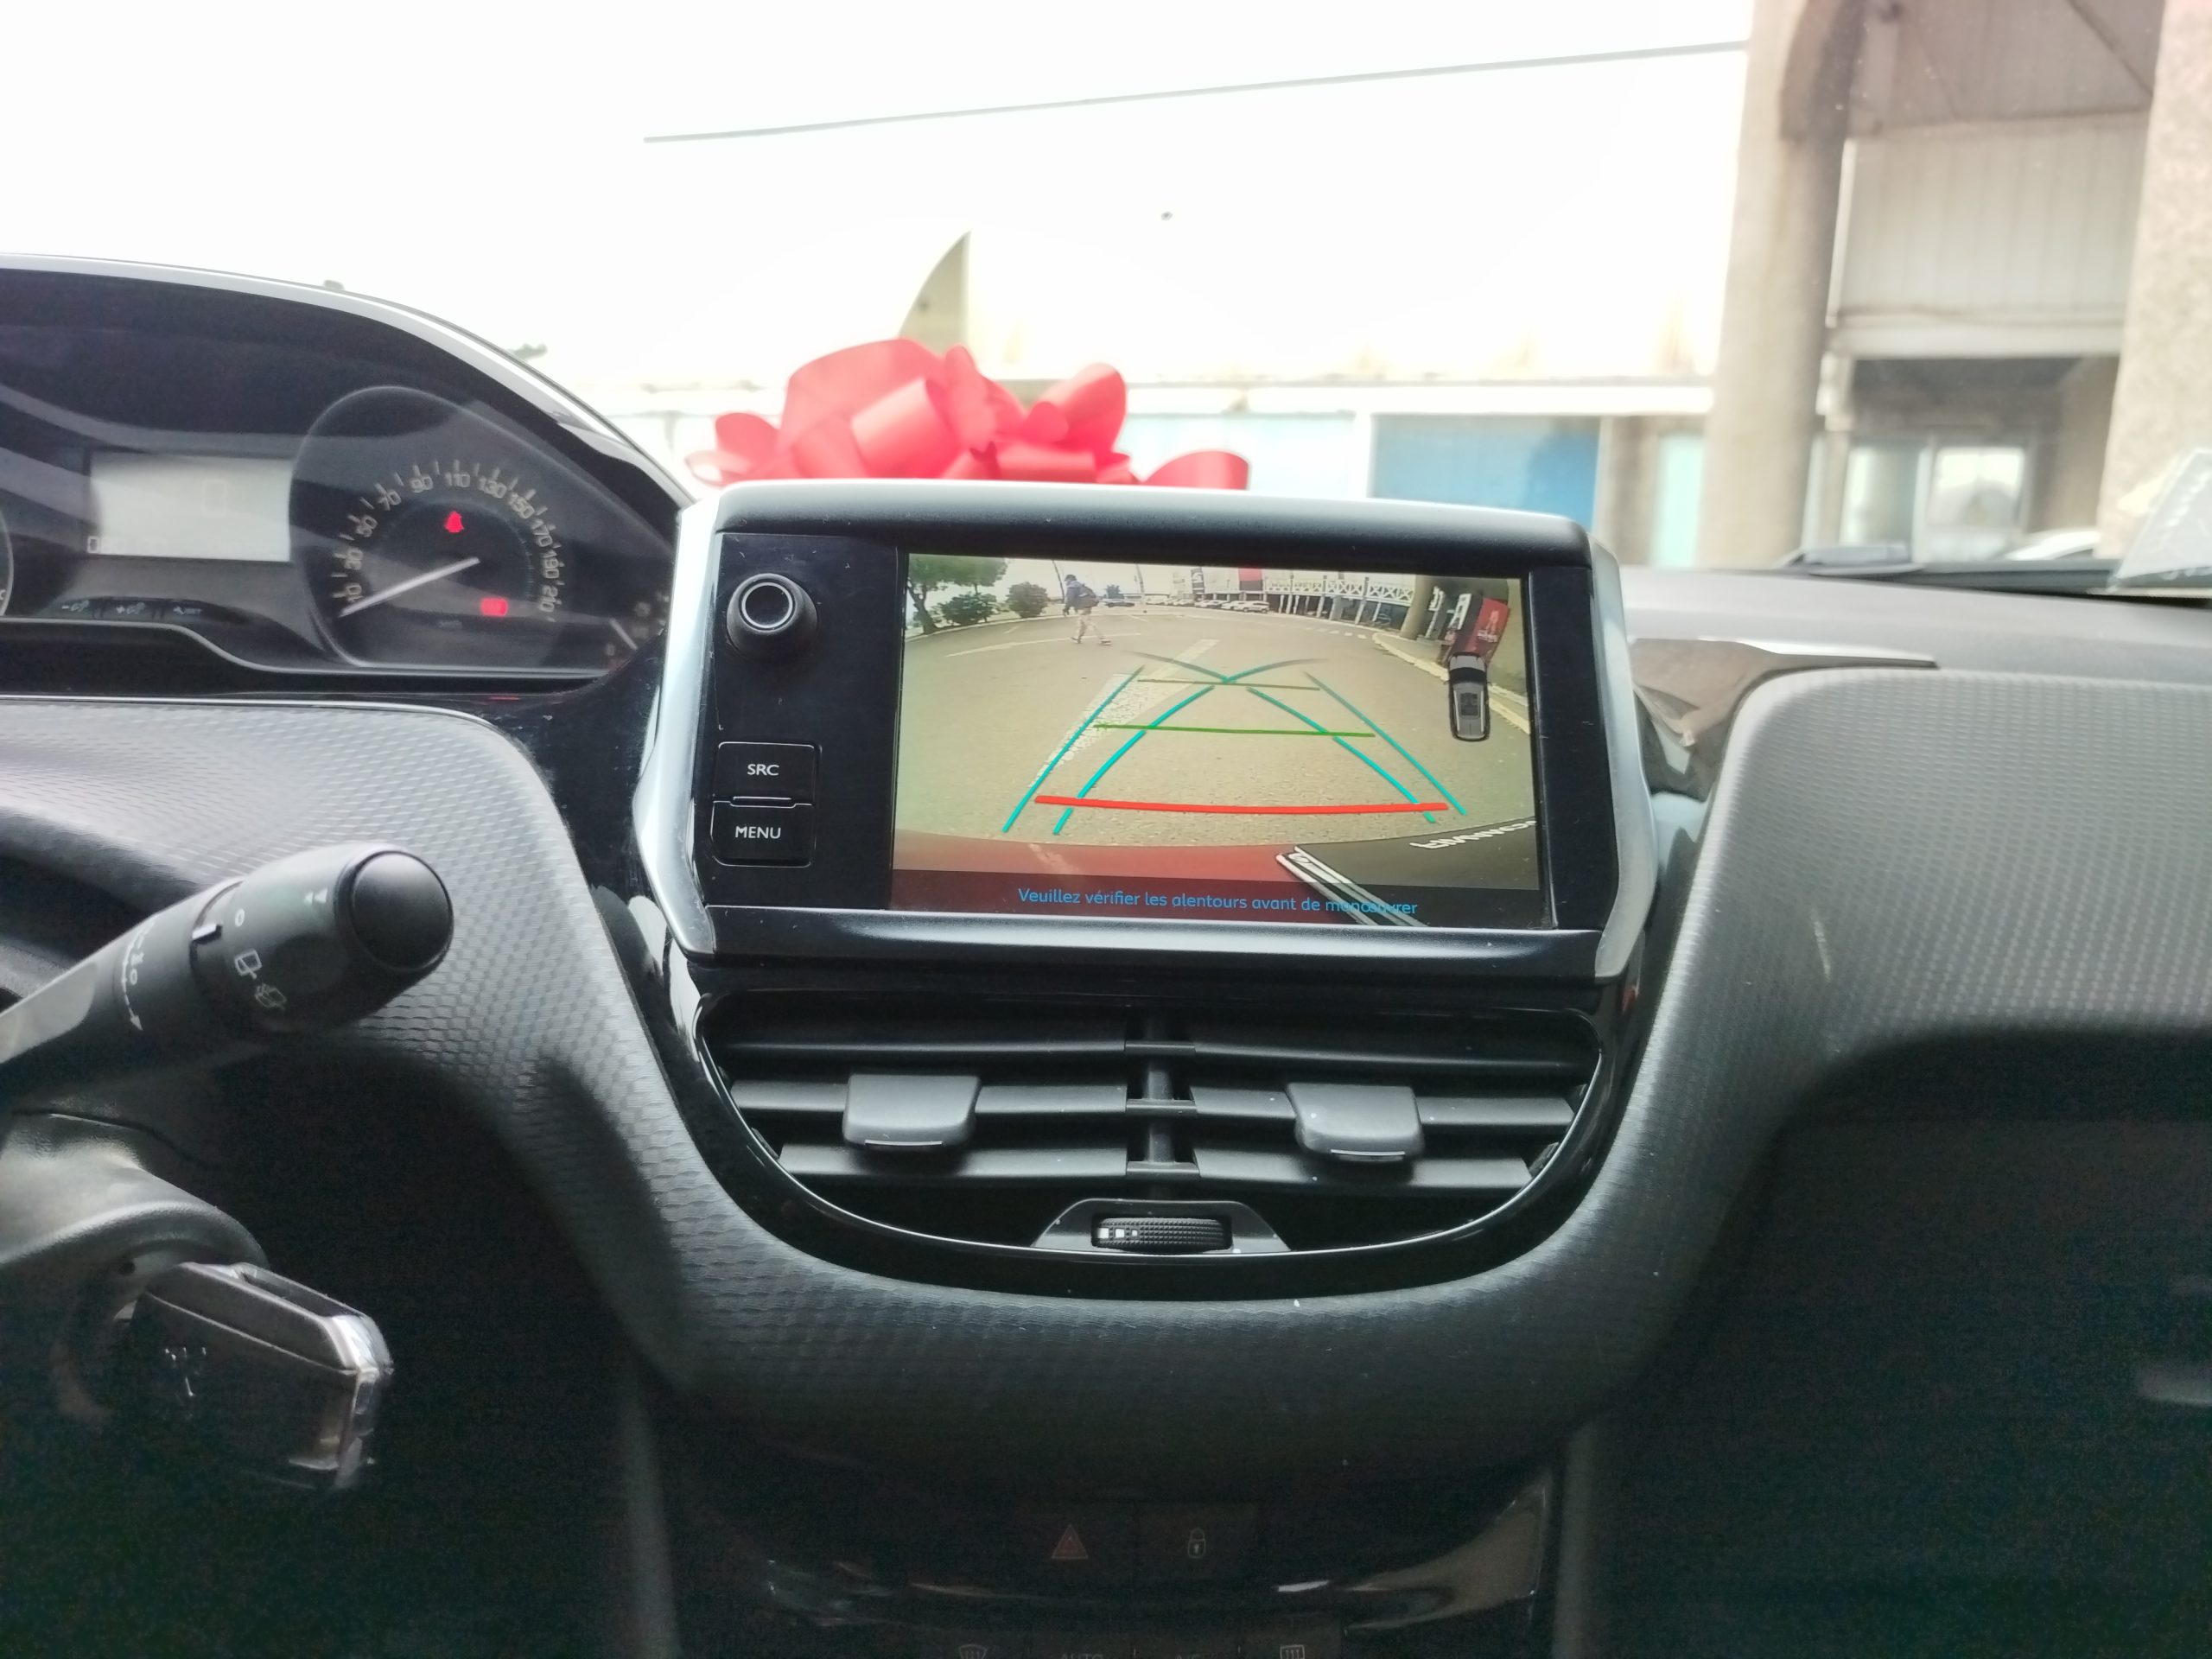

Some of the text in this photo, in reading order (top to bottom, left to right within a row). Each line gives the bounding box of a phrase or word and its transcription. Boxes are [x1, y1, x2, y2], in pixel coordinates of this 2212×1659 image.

[445, 473, 470, 487] 110
[478, 477, 507, 499] 130
[378, 489, 401, 511] 70
[508, 492, 535, 519] 150
[531, 519, 554, 548] 170
[747, 763, 779, 776] SRC
[734, 825, 781, 839] MENU
[1018, 887, 1080, 904] Veuillez
[1084, 890, 1140, 906] vérifier
[1145, 892, 1167, 906] les
[1172, 893, 1248, 909] alentours
[1252, 898, 1296, 911] avant
[1301, 897, 1320, 912] de
